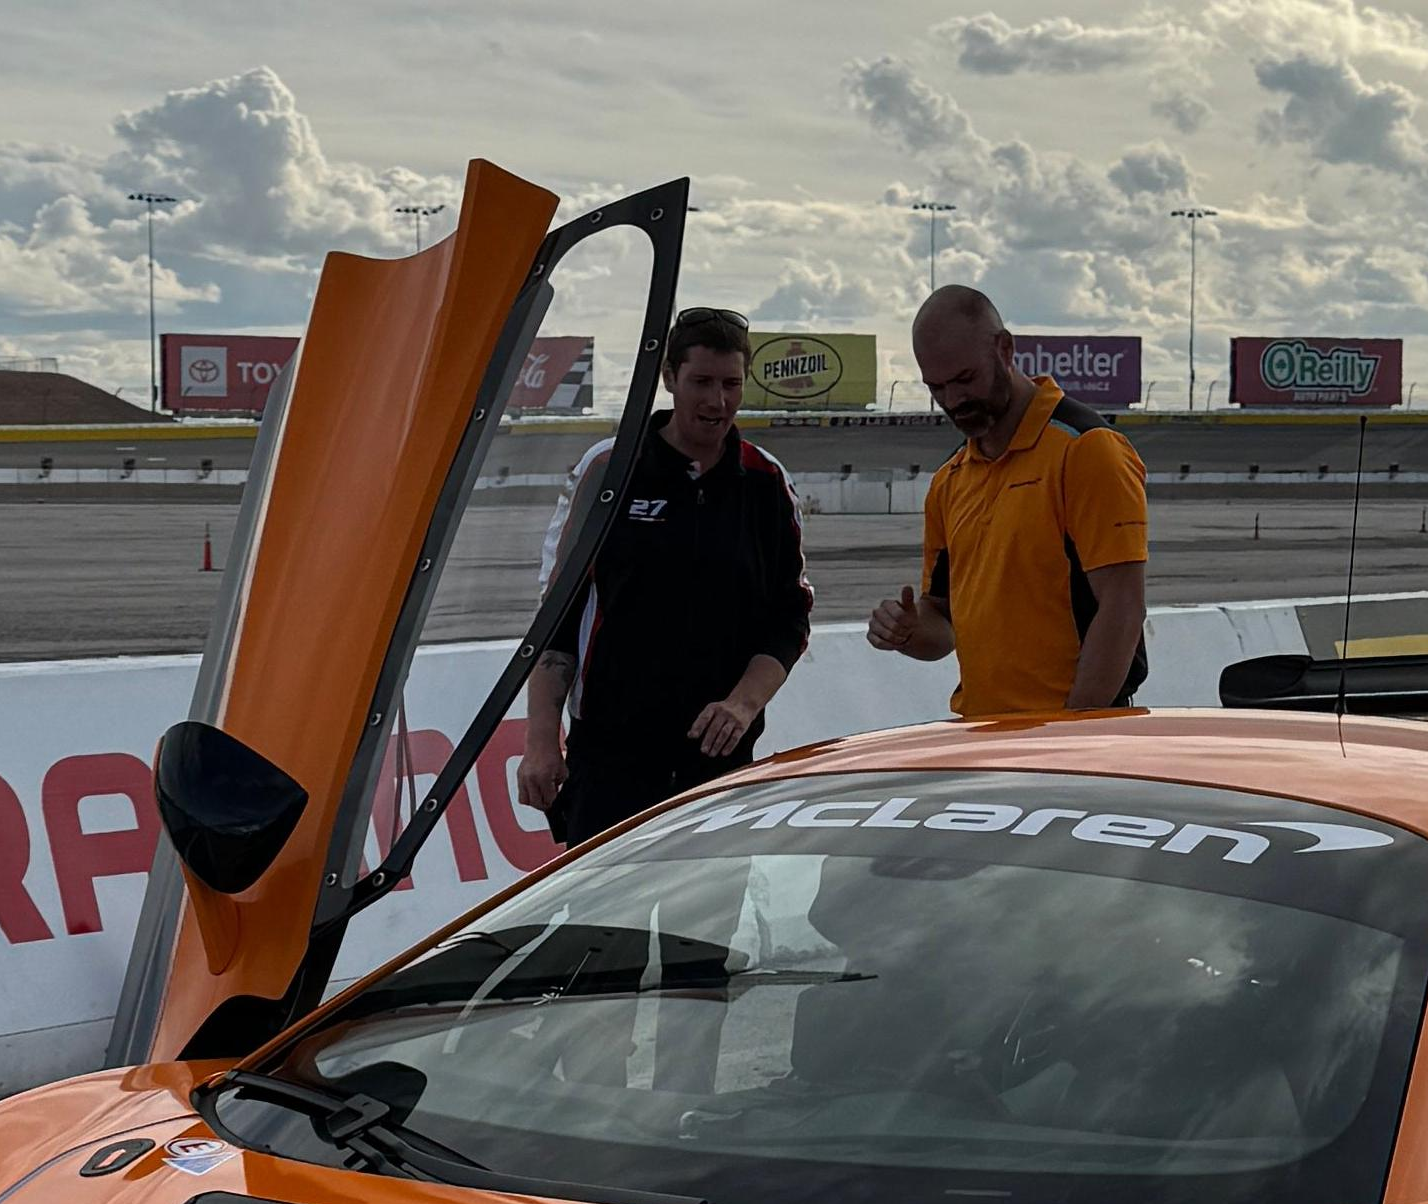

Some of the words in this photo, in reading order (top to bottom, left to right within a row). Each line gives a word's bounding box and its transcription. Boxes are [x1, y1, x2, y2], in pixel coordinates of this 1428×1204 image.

[763, 353, 829, 380] PENNZOIL
[1013, 344, 1124, 377] mbetter
[1264, 340, 1375, 391] O'Reilly
[629, 499, 668, 516] 27
[640, 797, 1270, 865] McLaren
